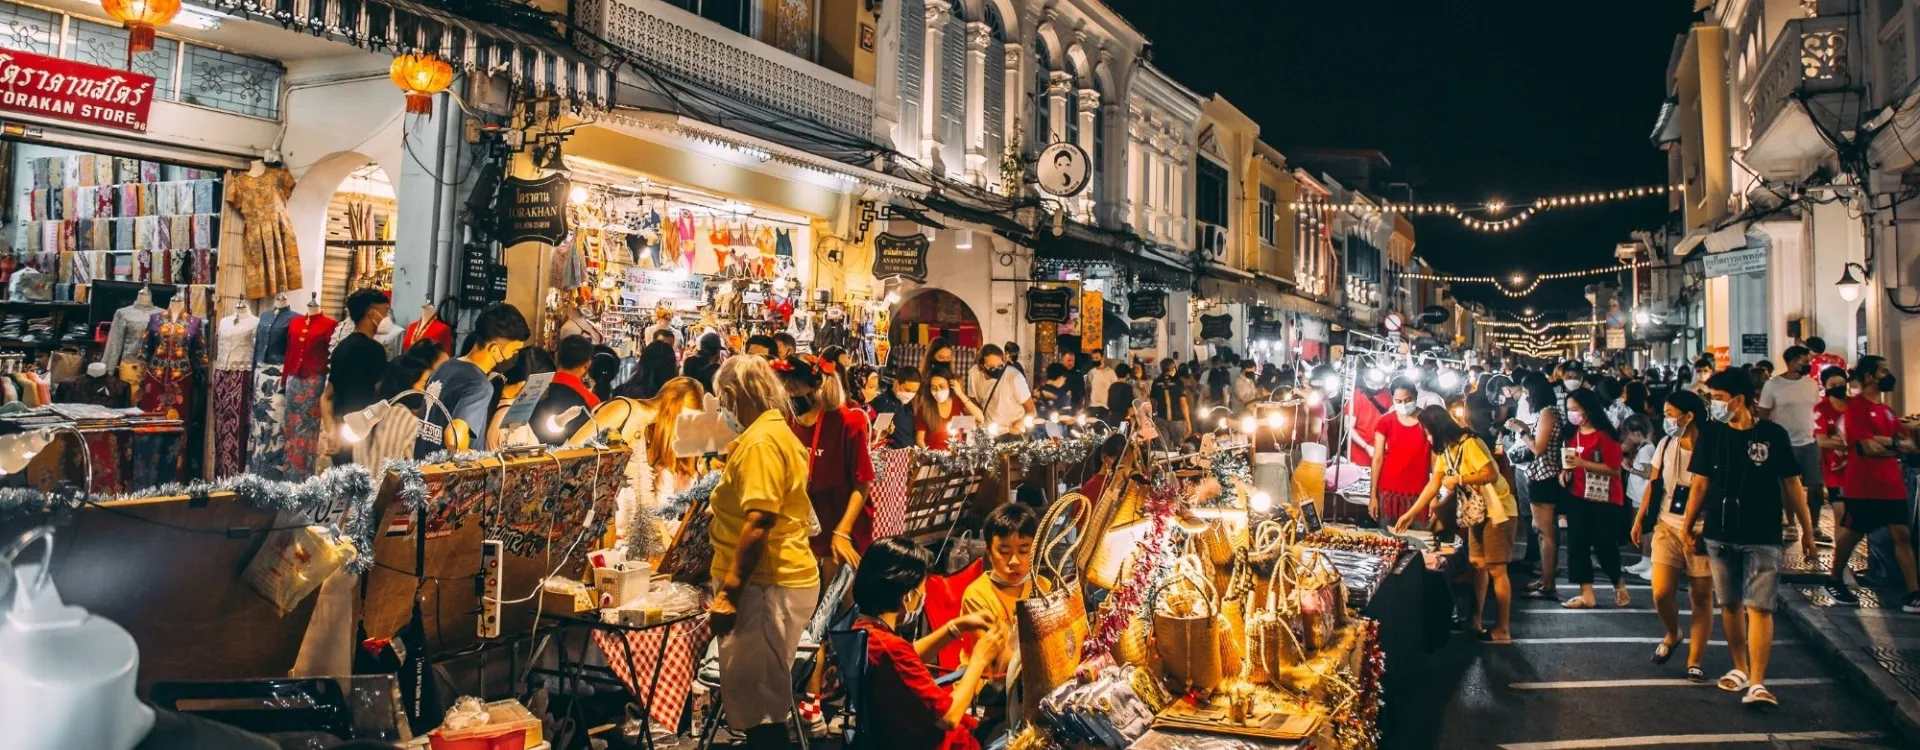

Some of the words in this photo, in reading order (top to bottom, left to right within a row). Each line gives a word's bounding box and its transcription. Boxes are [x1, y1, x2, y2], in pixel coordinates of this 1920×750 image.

[0, 89, 75, 115] ORAKAN
[81, 104, 136, 125] STORE
[134, 122, 146, 131] 96
[508, 205, 558, 218] TORAKHAN
